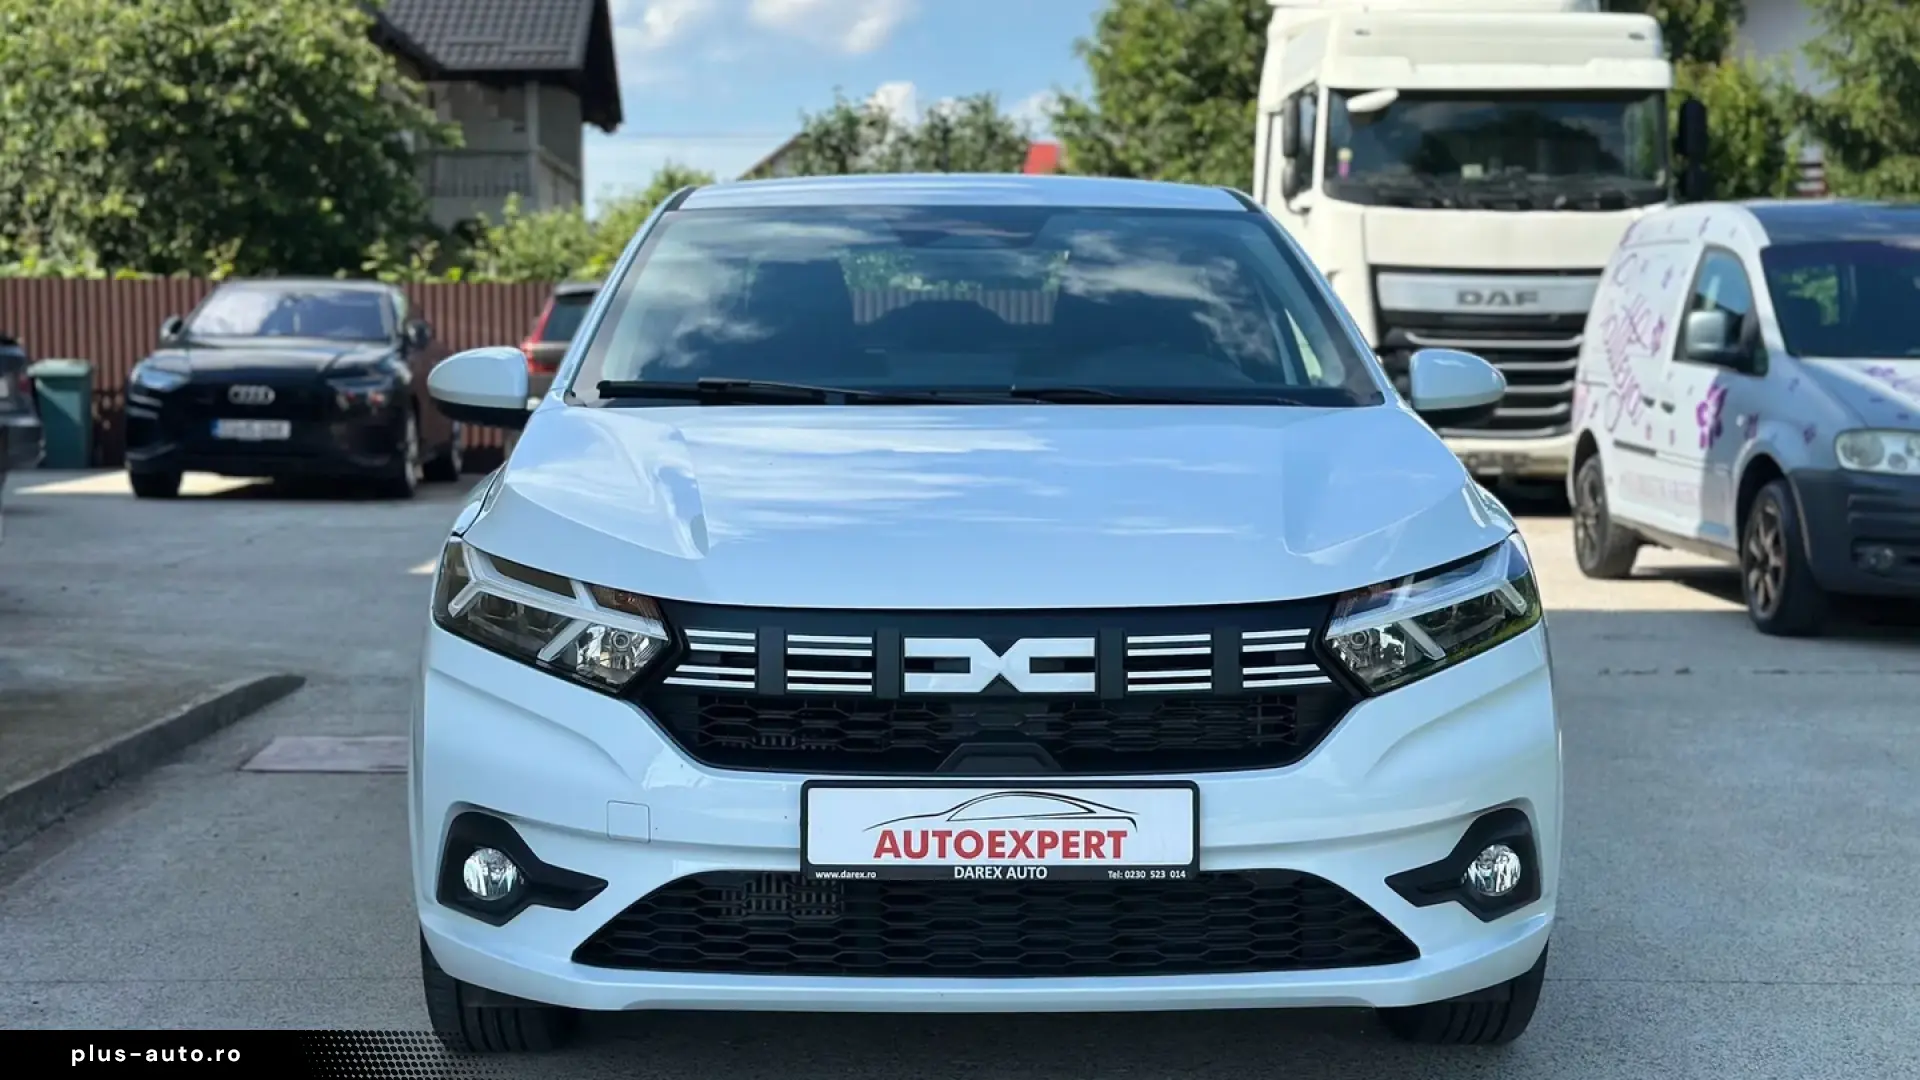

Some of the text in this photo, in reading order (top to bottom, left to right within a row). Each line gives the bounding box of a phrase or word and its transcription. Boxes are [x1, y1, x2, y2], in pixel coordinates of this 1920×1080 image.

[1457, 291, 1538, 306] DAF
[873, 829, 1128, 860] AUTOEXPERT
[815, 870, 877, 879] www.darex.ro
[954, 866, 1048, 879] DAREX AUTO
[1107, 870, 1186, 879] Tel: 0230 523 014
